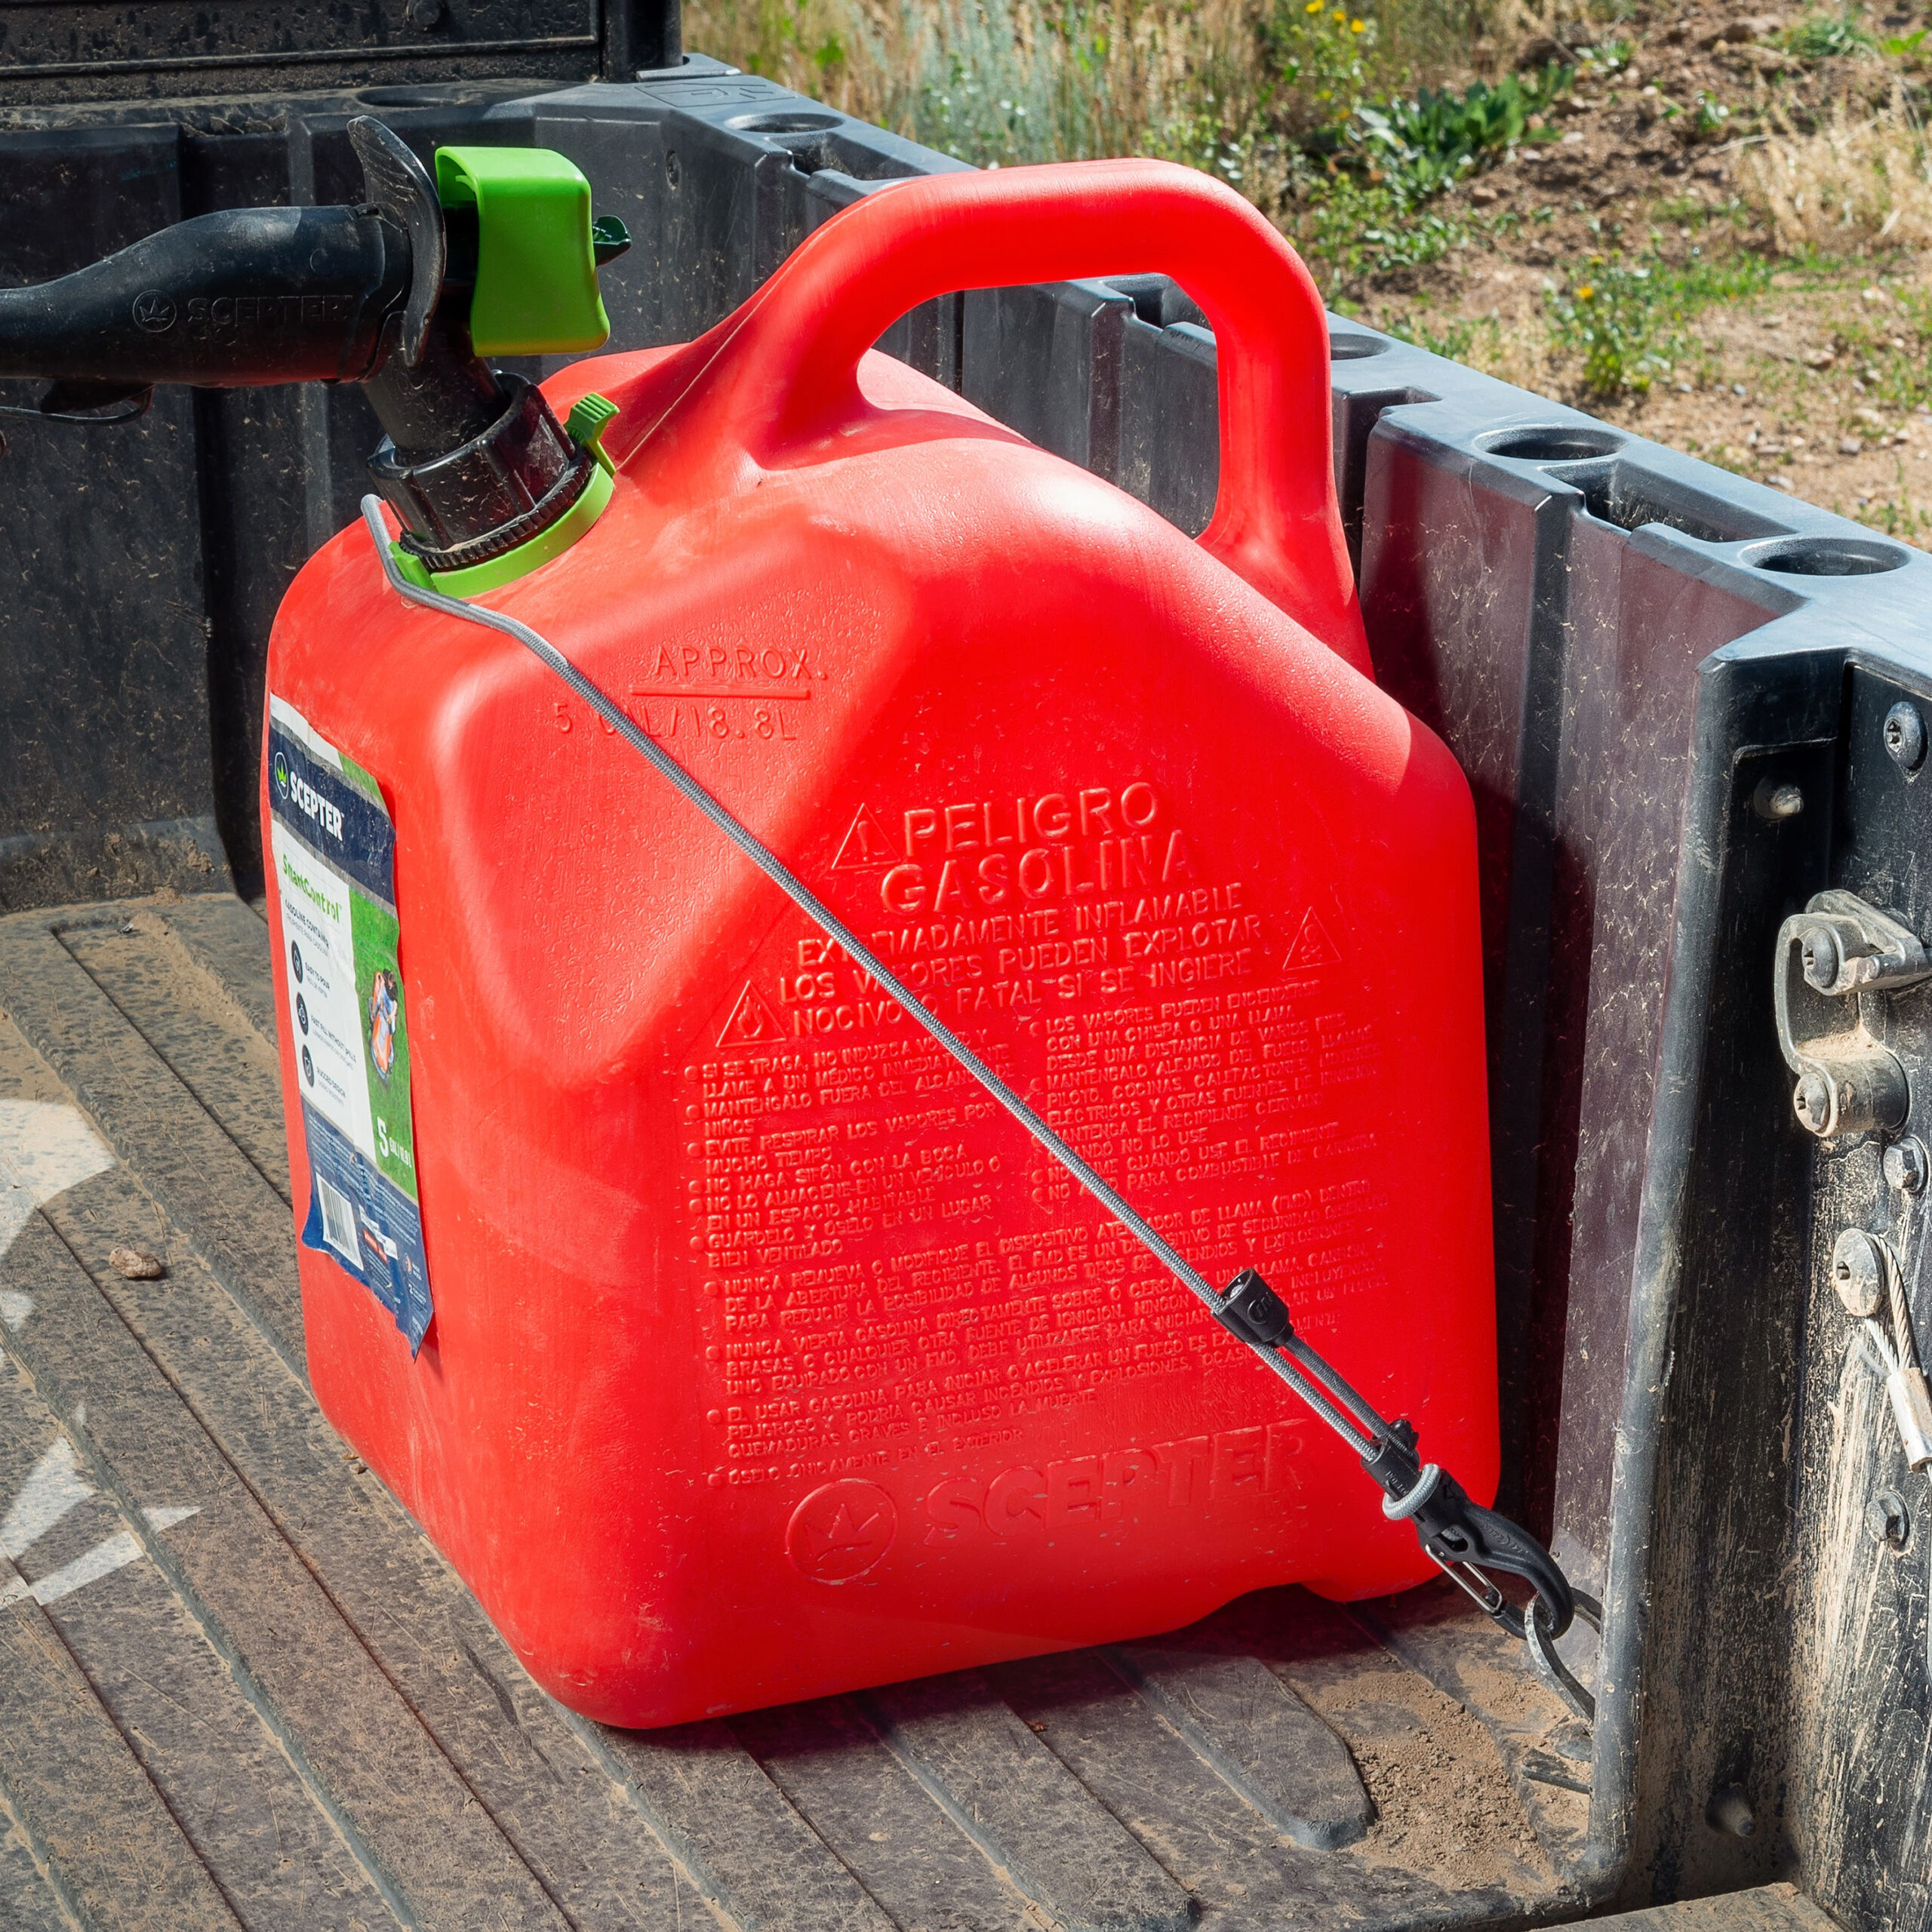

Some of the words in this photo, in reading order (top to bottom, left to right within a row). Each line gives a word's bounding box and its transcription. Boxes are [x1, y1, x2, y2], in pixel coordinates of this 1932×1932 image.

[187, 295, 347, 326] SCEPTER
[654, 646, 829, 681] APPROX.
[556, 703, 572, 734] 5
[289, 771, 343, 841] SCEPTER
[903, 782, 1158, 856] PELIGRO
[283, 854, 340, 923] SmartControl
[881, 829, 1195, 915] GASOLINA
[1074, 881, 1242, 932] INFLAMABLE
[780, 971, 835, 1004] LOS
[998, 937, 1109, 974] PUEDEN
[1125, 914, 1262, 960] EXPLOTAR
[793, 1001, 903, 1037] NOCIVO
[956, 979, 1042, 1014] FATAL
[1057, 972, 1084, 1000] SI
[1100, 964, 1135, 994] SE
[1150, 946, 1253, 989] INGIERE
[1046, 1014, 1075, 1035] LOS
[1082, 1007, 1153, 1027] VAPORES
[1161, 995, 1220, 1020] PUEDEN
[1046, 1033, 1081, 1052] CON
[1088, 1029, 1121, 1048] UNA
[1124, 1021, 1183, 1042] CHISPA
[1189, 1017, 1202, 1033] O
[1209, 1012, 1241, 1031] UNA
[1248, 1004, 1295, 1026] LLAMA
[1046, 1050, 1098, 1071] DESDE
[1104, 1045, 1137, 1065] UNA
[1146, 1034, 1221, 1058] DISTANCIA
[1230, 1029, 1250, 1047] DE
[1257, 1019, 1309, 1042] VARIOS
[723, 1060, 745, 1076] SE
[814, 1051, 837, 1068] NO
[842, 1040, 912, 1064] INDUZCA
[1155, 1053, 1221, 1076] ALEJADO
[1229, 1048, 1252, 1066] DEL
[703, 1079, 755, 1099] LLAME
[783, 1074, 808, 1091] UN
[820, 1084, 872, 1106] FUERA
[878, 1080, 906, 1097] DEL
[1149, 1097, 1160, 1114] Y
[1165, 1089, 1216, 1112] OTRAS
[1223, 1079, 1288, 1103] FUENTES
[377, 1116, 389, 1158] 5
[705, 1137, 752, 1156] EVITE
[759, 1124, 839, 1150] RESPIRAR
[846, 1120, 878, 1140] LOS
[885, 1106, 957, 1133] VAPORES
[964, 1101, 996, 1121] POR
[1121, 1136, 1142, 1154] NO
[1151, 1133, 1171, 1150] LO
[1177, 1127, 1208, 1146] USE
[1137, 1115, 1157, 1134] EL
[1163, 1102, 1248, 1130] RECIPIENTE
[706, 1154, 768, 1174] MUCHO
[774, 1147, 832, 1168] TIEMPO
[706, 1177, 731, 1193] NO
[740, 1171, 788, 1192] HAGA
[850, 1155, 884, 1176] CON
[892, 1152, 912, 1170] LA
[921, 1143, 967, 1165] BOCA
[1048, 1183, 1070, 1201] NO
[1127, 1170, 1168, 1192] PARA
[1175, 1151, 1279, 1183] COMBUSTIBLE
[1127, 1147, 1190, 1172] CUANDO
[1198, 1141, 1228, 1161] USE
[706, 1195, 731, 1212] NO
[737, 1192, 758, 1210] LO
[764, 1180, 851, 1207] ALMACENE
[882, 1172, 904, 1191] UN
[707, 1214, 730, 1232] EN
[736, 1211, 760, 1228] UN
[768, 1202, 841, 1226] ESPACIO
[847, 1186, 937, 1214] HABITABLE
[909, 1205, 934, 1223] UN
[942, 1194, 992, 1218] LUGAR
[708, 1250, 749, 1269] BIEN
[757, 1238, 843, 1264] VENTILADO
[724, 1274, 784, 1296] NUNCA
[791, 1263, 865, 1289] REMUEVA
[891, 1243, 970, 1273] MODIFIQUE
[999, 1226, 1088, 1254] DISPOSITIVO
[1191, 1208, 1211, 1226] DE
[1217, 1200, 1266, 1221] LLAMA
[724, 1297, 747, 1315] DE
[755, 1294, 777, 1312] LA
[785, 1281, 870, 1307] ABERTURA
[877, 1275, 905, 1294] DEL
[1032, 1247, 1065, 1268] FMD
[1068, 1244, 1088, 1263] ES
[1094, 1240, 1115, 1258] UN
[1217, 1222, 1237, 1239] DE
[724, 1312, 771, 1333] PARA
[780, 1303, 849, 1328] REDUCIR
[857, 1299, 877, 1318] LA
[884, 1281, 975, 1312] POSIBILIDAD
[1009, 1264, 1078, 1291] ALGUNOS
[1083, 1257, 1125, 1278] TIPOS
[724, 1338, 785, 1359] NUNCA
[792, 1330, 849, 1353] VIERTA
[855, 1316, 930, 1344] GASOLINA
[936, 1295, 1048, 1330] DIRECTAMENTE
[1051, 1287, 1103, 1309] SOBRE
[1129, 1277, 1178, 1300] CERCA
[725, 1357, 795, 1377] BRASAS
[823, 1339, 912, 1364] CUALQUIER
[918, 1331, 959, 1349] OTRA
[966, 1318, 1023, 1343] FUENTE
[725, 1377, 764, 1395] UNO
[772, 1366, 850, 1391] EQUIPADO
[854, 1361, 888, 1380] CON
[896, 1355, 918, 1373] UN
[968, 1340, 1010, 1360] DEBE
[1016, 1324, 1100, 1352] UTILIZARSE
[1107, 1317, 1147, 1336] PARA
[1152, 1308, 1208, 1331] INICIAR
[726, 1405, 746, 1423] EL
[755, 1399, 801, 1420] USAR
[808, 1388, 888, 1413] GASOLINA
[895, 1378, 937, 1401] PARA
[945, 1368, 1001, 1390] INICIAR
[1025, 1351, 1103, 1375] ACELERAR
[1107, 1346, 1131, 1366] UN
[1133, 1337, 1183, 1361] FUEGO
[726, 1417, 817, 1440] PELIGROSO
[910, 1389, 979, 1415] CAUSAR
[983, 1375, 1066, 1403] INCENDIOS
[726, 1432, 841, 1460] QUEMADURAS
[848, 1420, 912, 1444] GRAVES
[937, 1404, 1001, 1431] INCLUSO
[1010, 1398, 1028, 1416] LA
[1035, 1388, 1097, 1411] MUERTE
[952, 1426, 1025, 1453] EXTERIOR
[924, 1418, 1308, 1548] SCEPTER
